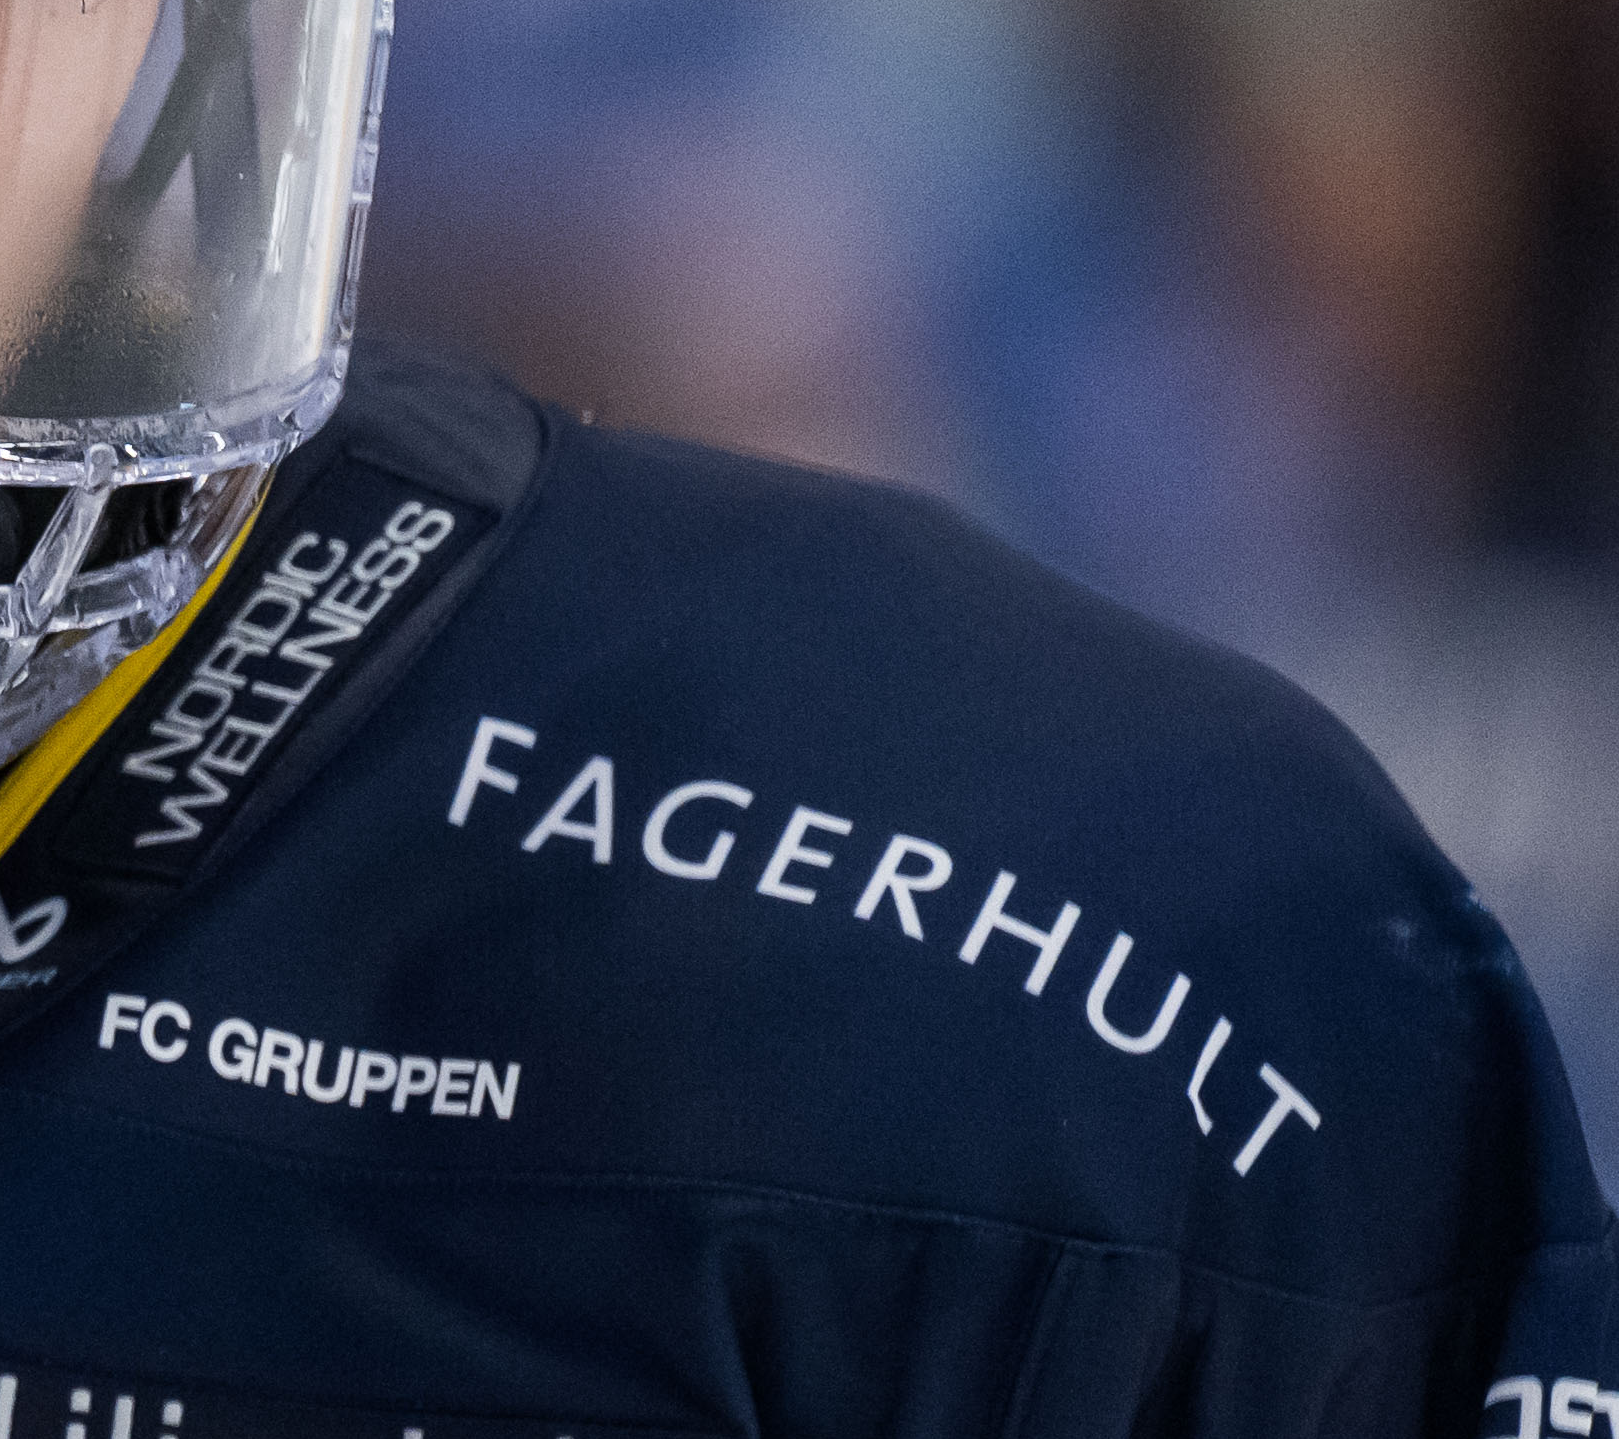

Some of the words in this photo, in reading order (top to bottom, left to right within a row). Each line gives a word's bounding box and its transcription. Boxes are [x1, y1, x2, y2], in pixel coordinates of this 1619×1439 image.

[120, 530, 346, 782] NORDIC
[134, 500, 456, 849] WELLNESS
[98, 993, 191, 1063] FC
[207, 1018, 522, 1120] GRUPPEN
[446, 715, 1322, 1177] FAGERHULT
